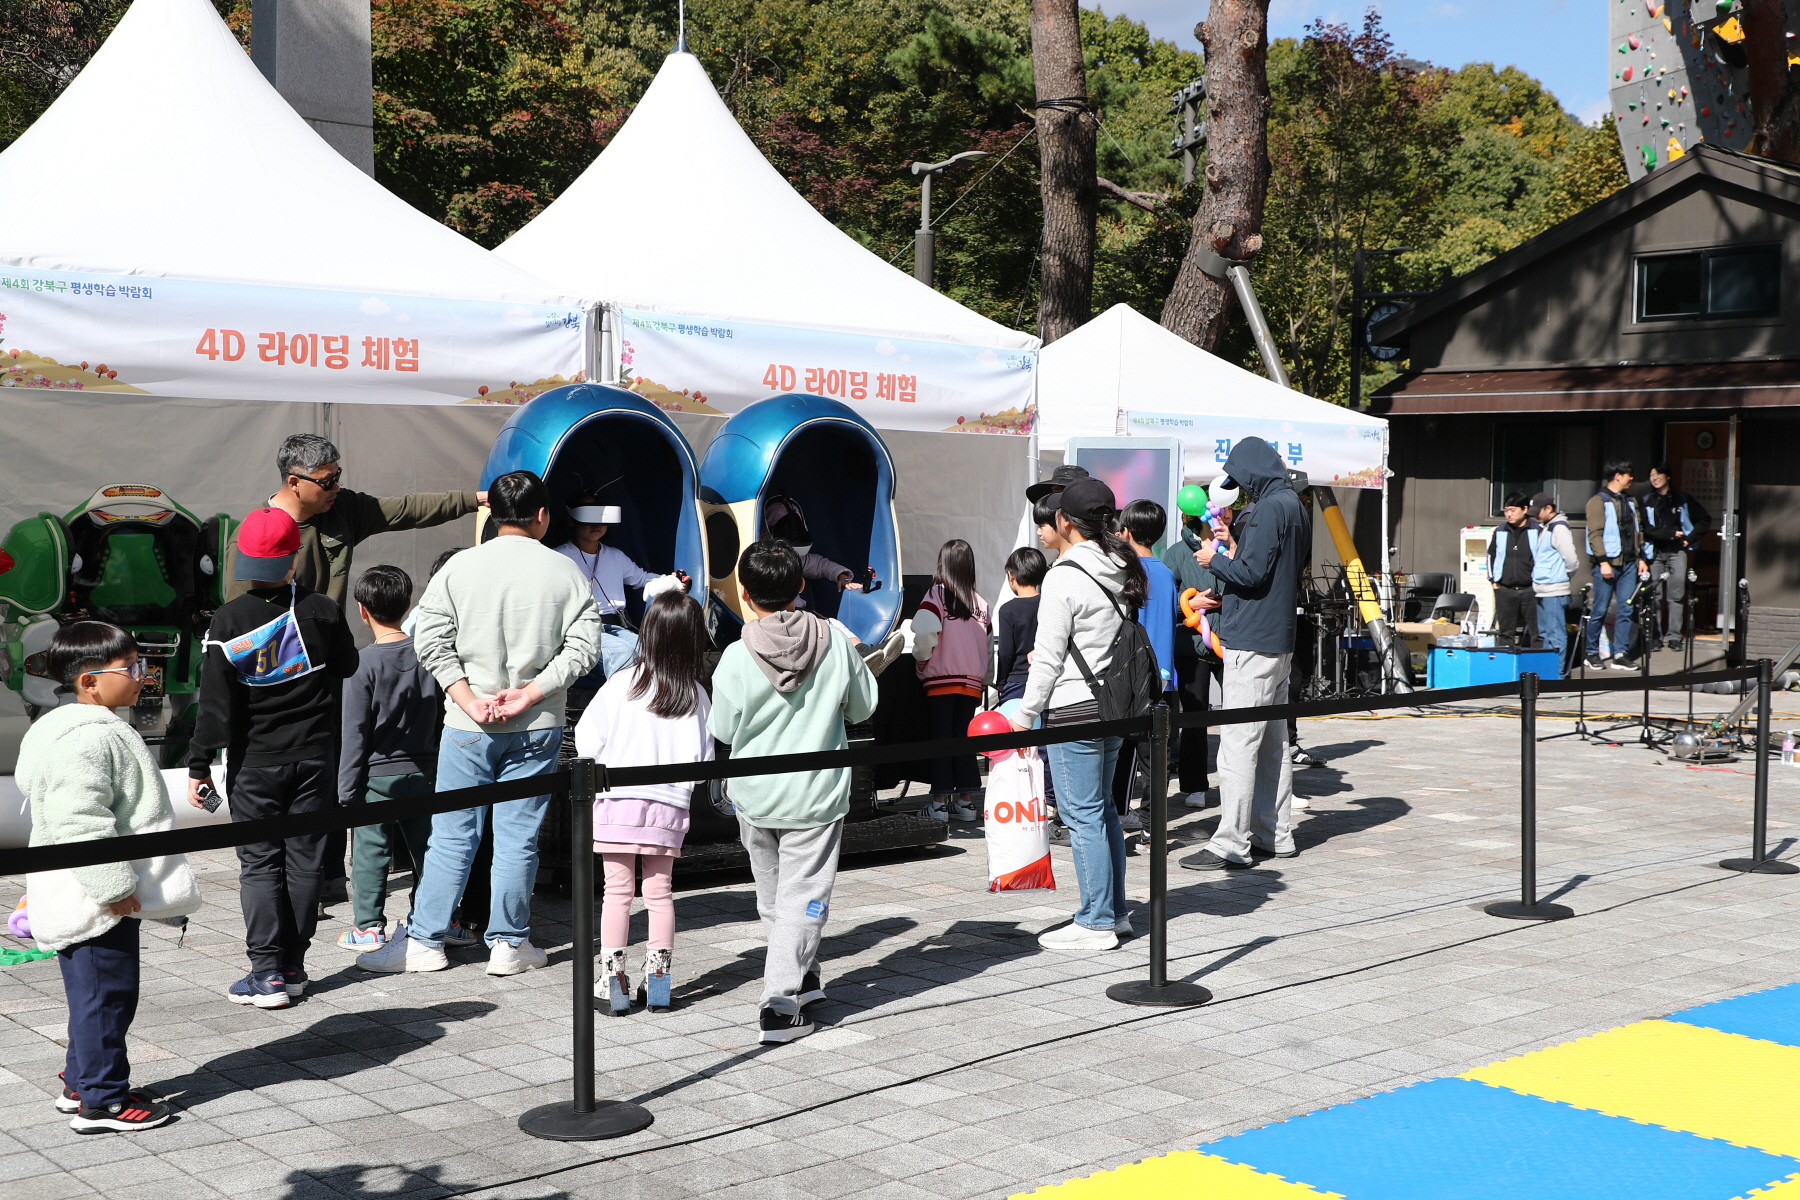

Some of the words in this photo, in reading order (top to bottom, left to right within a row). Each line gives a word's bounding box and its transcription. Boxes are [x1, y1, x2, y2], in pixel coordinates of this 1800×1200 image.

[1, 277, 30, 290] 제4회
[32, 279, 68, 293] 강북구
[70, 281, 117, 297] 평생학습
[119, 285, 153, 299] 박람회
[562, 312, 580, 332] 강북
[632, 318, 653, 330] 제4회
[653, 321, 676, 333] 강북구
[678, 323, 709, 337] 평생학습
[710, 327, 733, 339] 박람회
[195, 328, 246, 362] 4D
[257, 331, 350, 370] 라이딩
[361, 336, 419, 372] 체험
[762, 363, 797, 391] 4D
[804, 367, 868, 400] 라이딩
[875, 372, 917, 403] 체험
